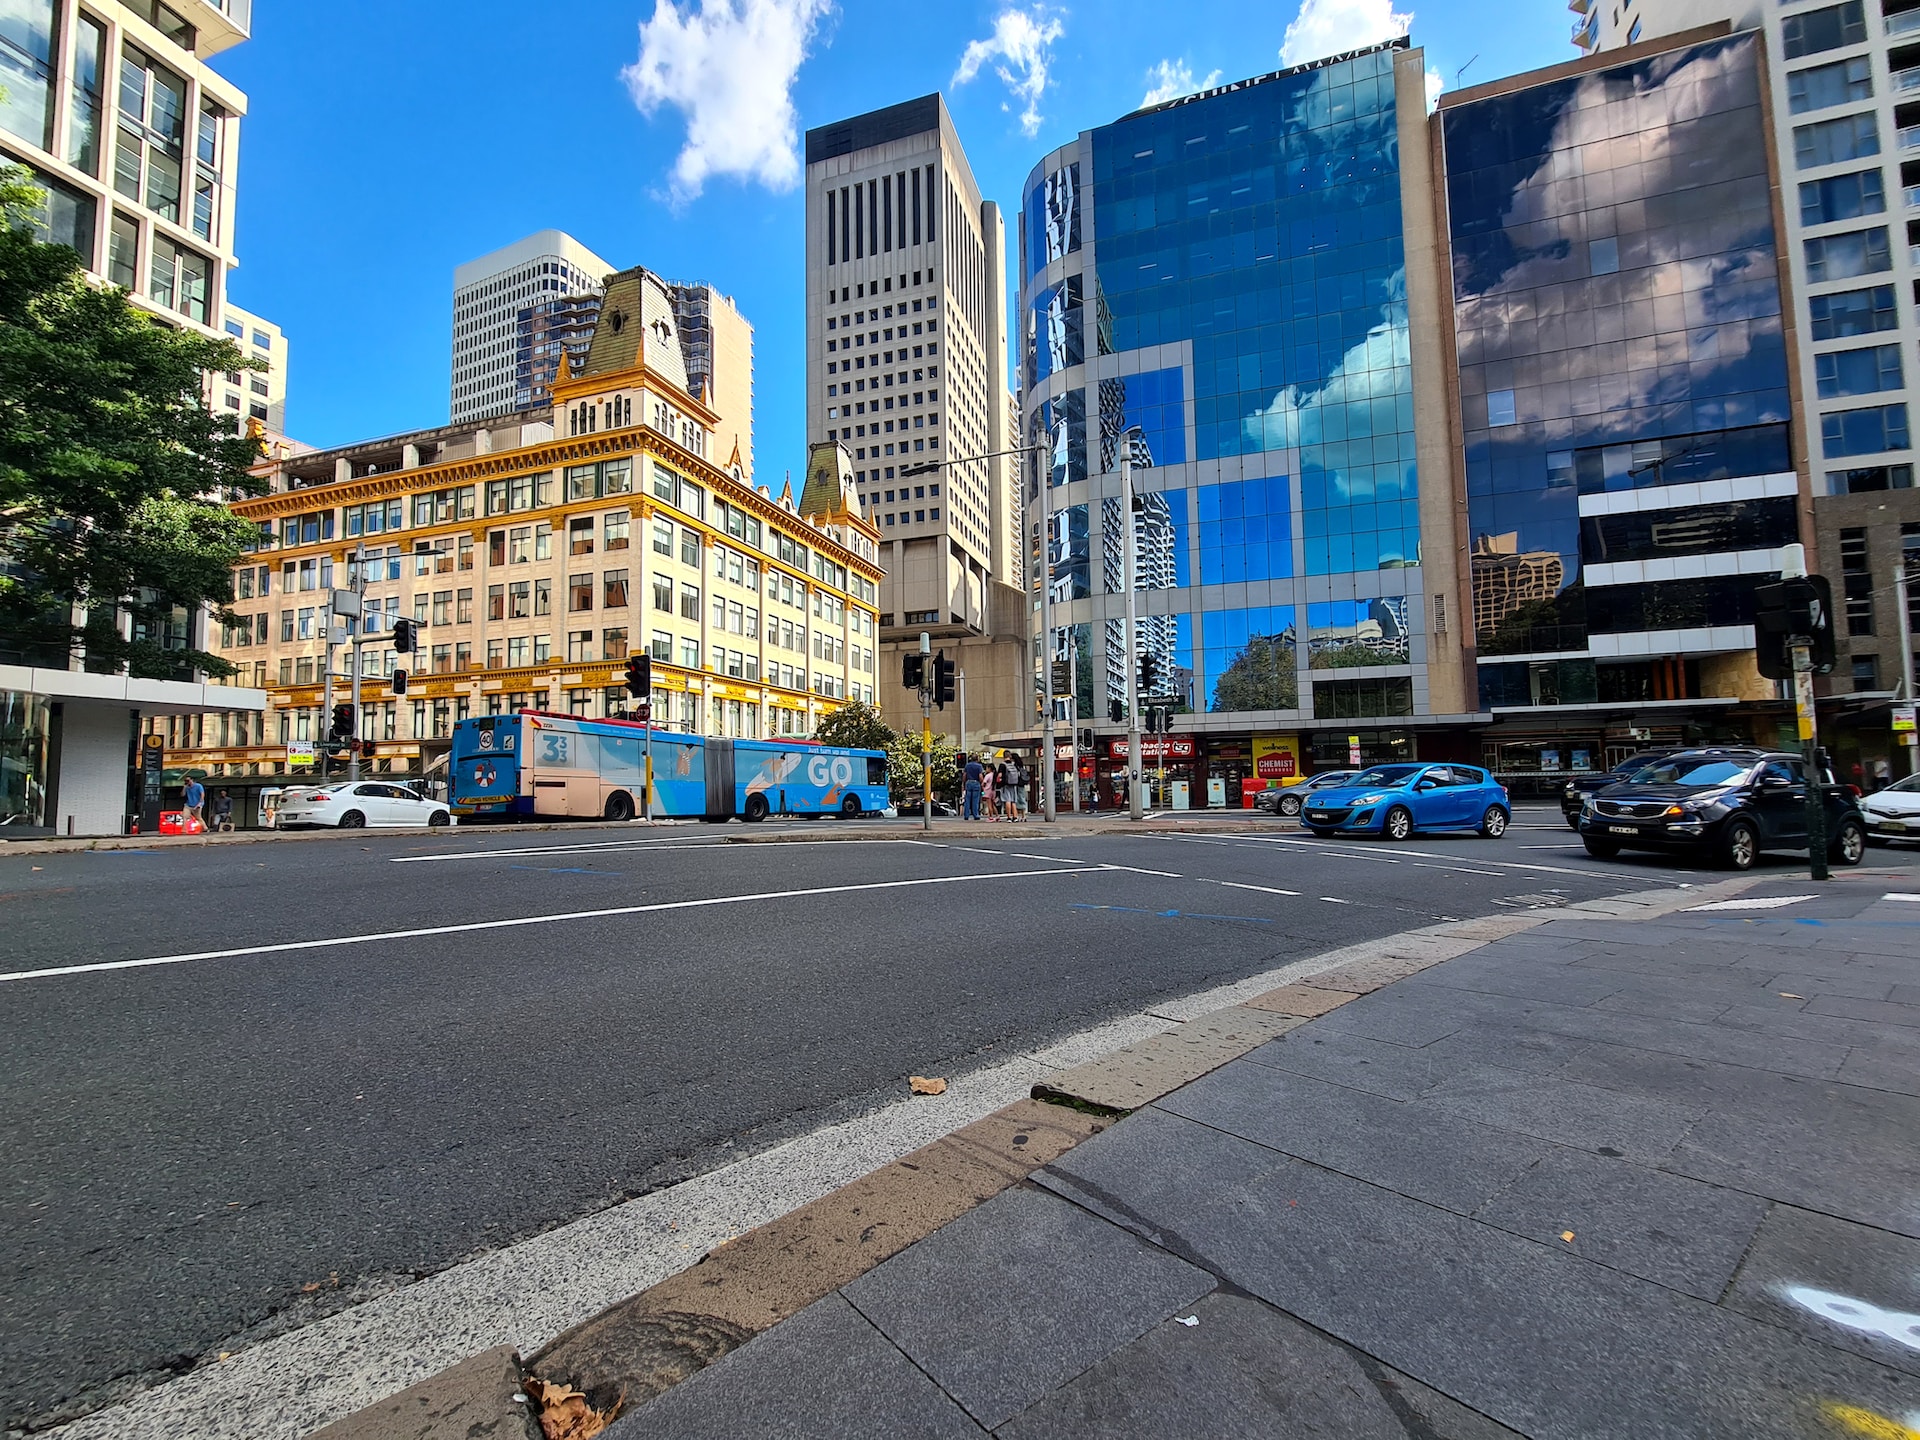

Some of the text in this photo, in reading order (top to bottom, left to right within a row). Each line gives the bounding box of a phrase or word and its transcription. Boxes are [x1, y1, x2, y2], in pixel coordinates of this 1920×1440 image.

[637, 708, 650, 717] STOP
[481, 734, 491, 746] 40
[1258, 760, 1293, 768] CHEMIST
[807, 755, 852, 787] GO
